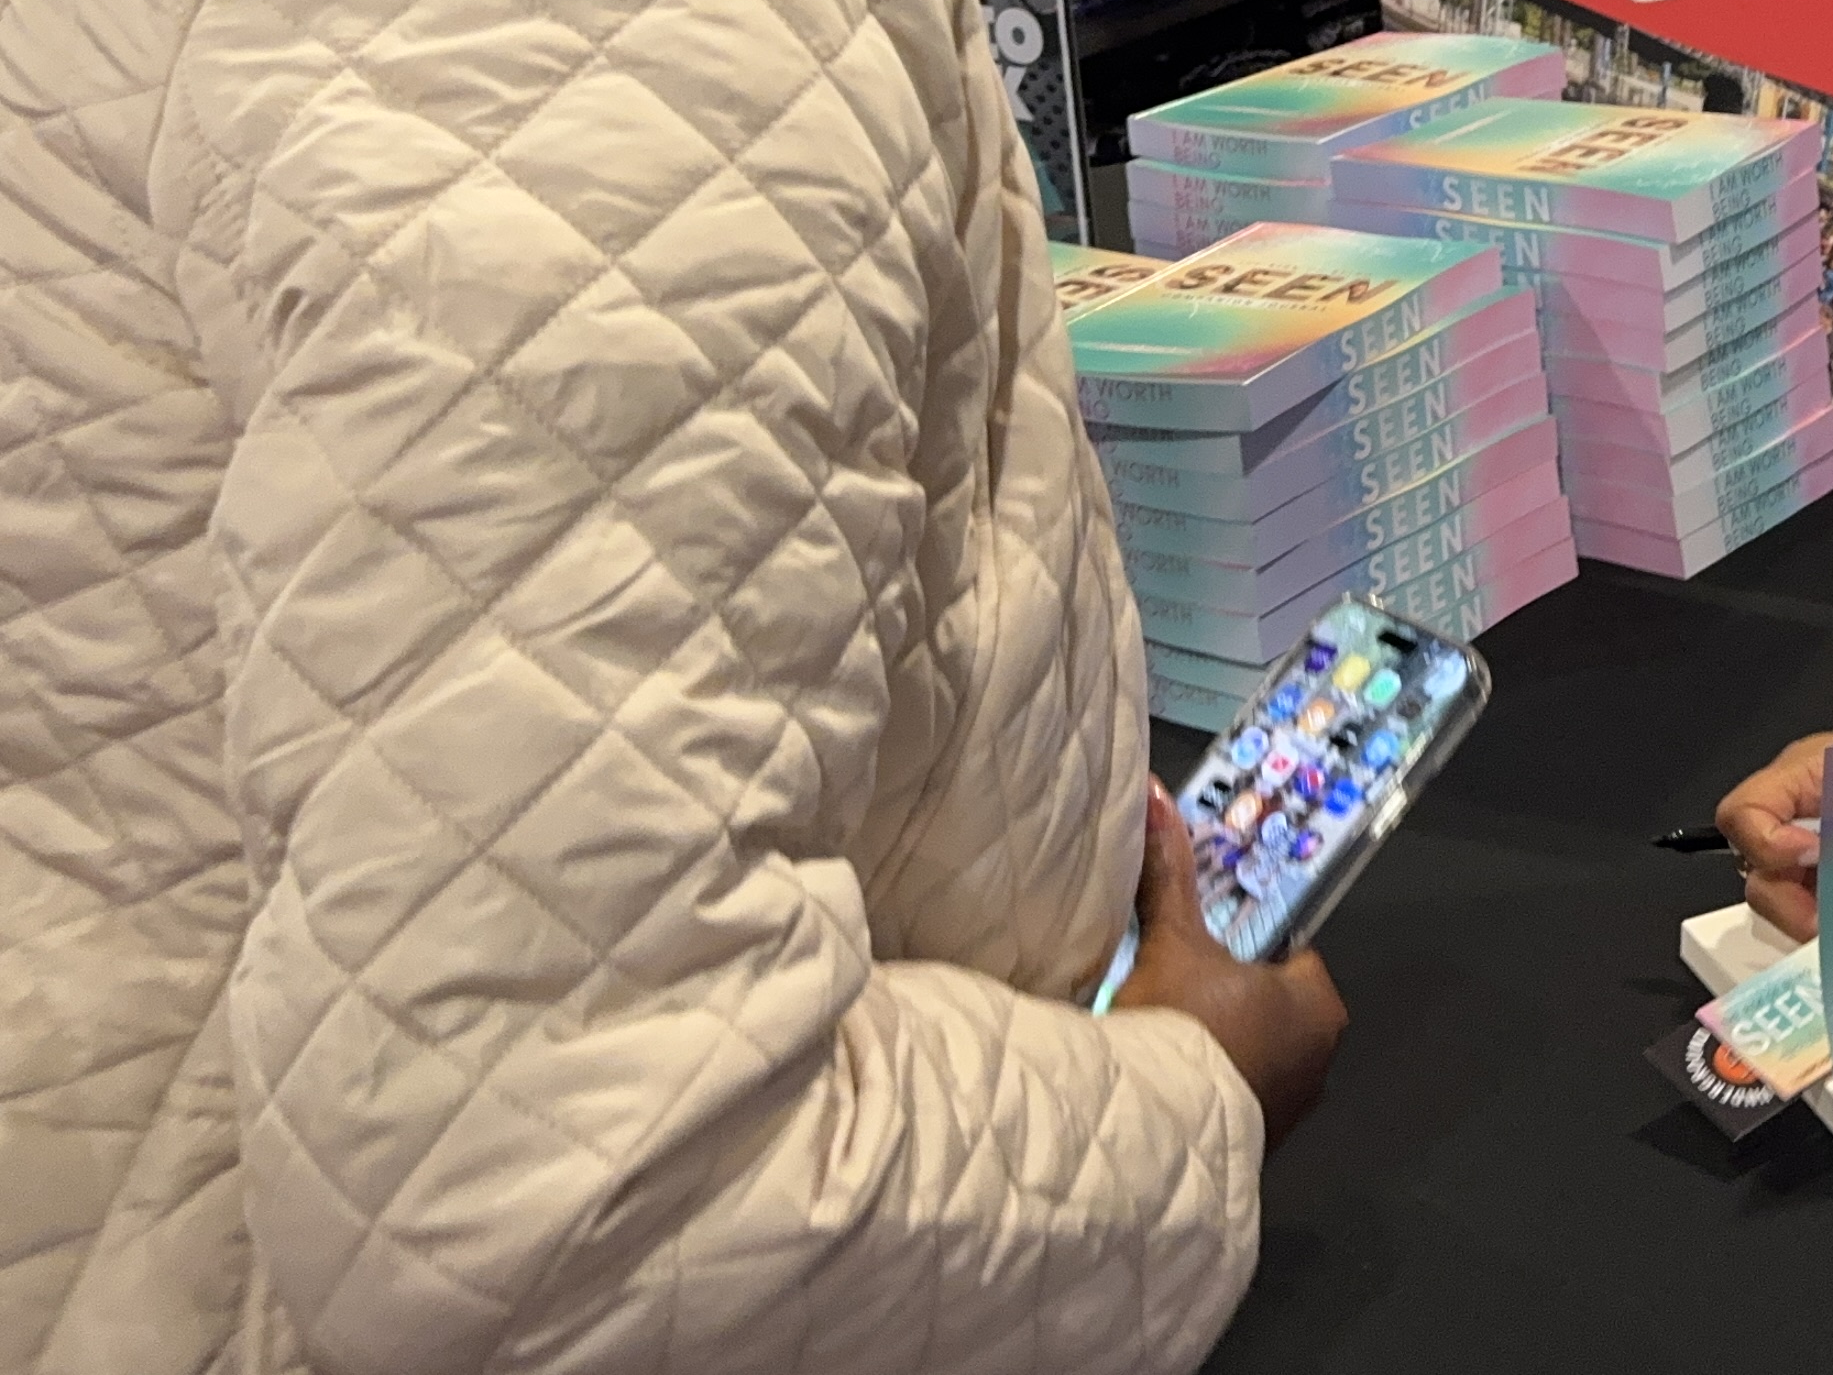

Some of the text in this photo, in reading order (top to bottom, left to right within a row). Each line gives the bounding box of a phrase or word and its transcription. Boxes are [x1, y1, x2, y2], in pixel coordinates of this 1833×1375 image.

[1288, 57, 1472, 89] SEEN
[1173, 145, 1222, 170] BEING
[1183, 130, 1206, 147] AM
[1211, 134, 1268, 156] WORTH
[1741, 150, 1784, 186] WORTH
[1174, 191, 1225, 215] BEING
[1212, 180, 1271, 202] WORTH
[1441, 174, 1551, 223] SEEN
[1711, 188, 1752, 222] BEING
[1702, 234, 1744, 270] BEING
[1165, 264, 1399, 306] SEEN
[1702, 275, 1745, 310] BEING
[1340, 293, 1422, 373] SEEN
[1705, 317, 1746, 349] BEING
[1099, 381, 1174, 404] WORTH
[1348, 338, 1442, 416] SEEN
[1741, 357, 1788, 394] WORTH
[1353, 382, 1447, 461] SEEN
[1710, 400, 1751, 432] BEING
[1361, 425, 1454, 505] SEEN
[1749, 437, 1796, 475] WORTH
[1366, 470, 1461, 551] SEEN
[1717, 478, 1760, 512] BEING
[1754, 473, 1800, 513] WORTH
[1724, 515, 1765, 553] BEING
[1369, 514, 1464, 595] SEEN
[1385, 555, 1476, 621] EEN
